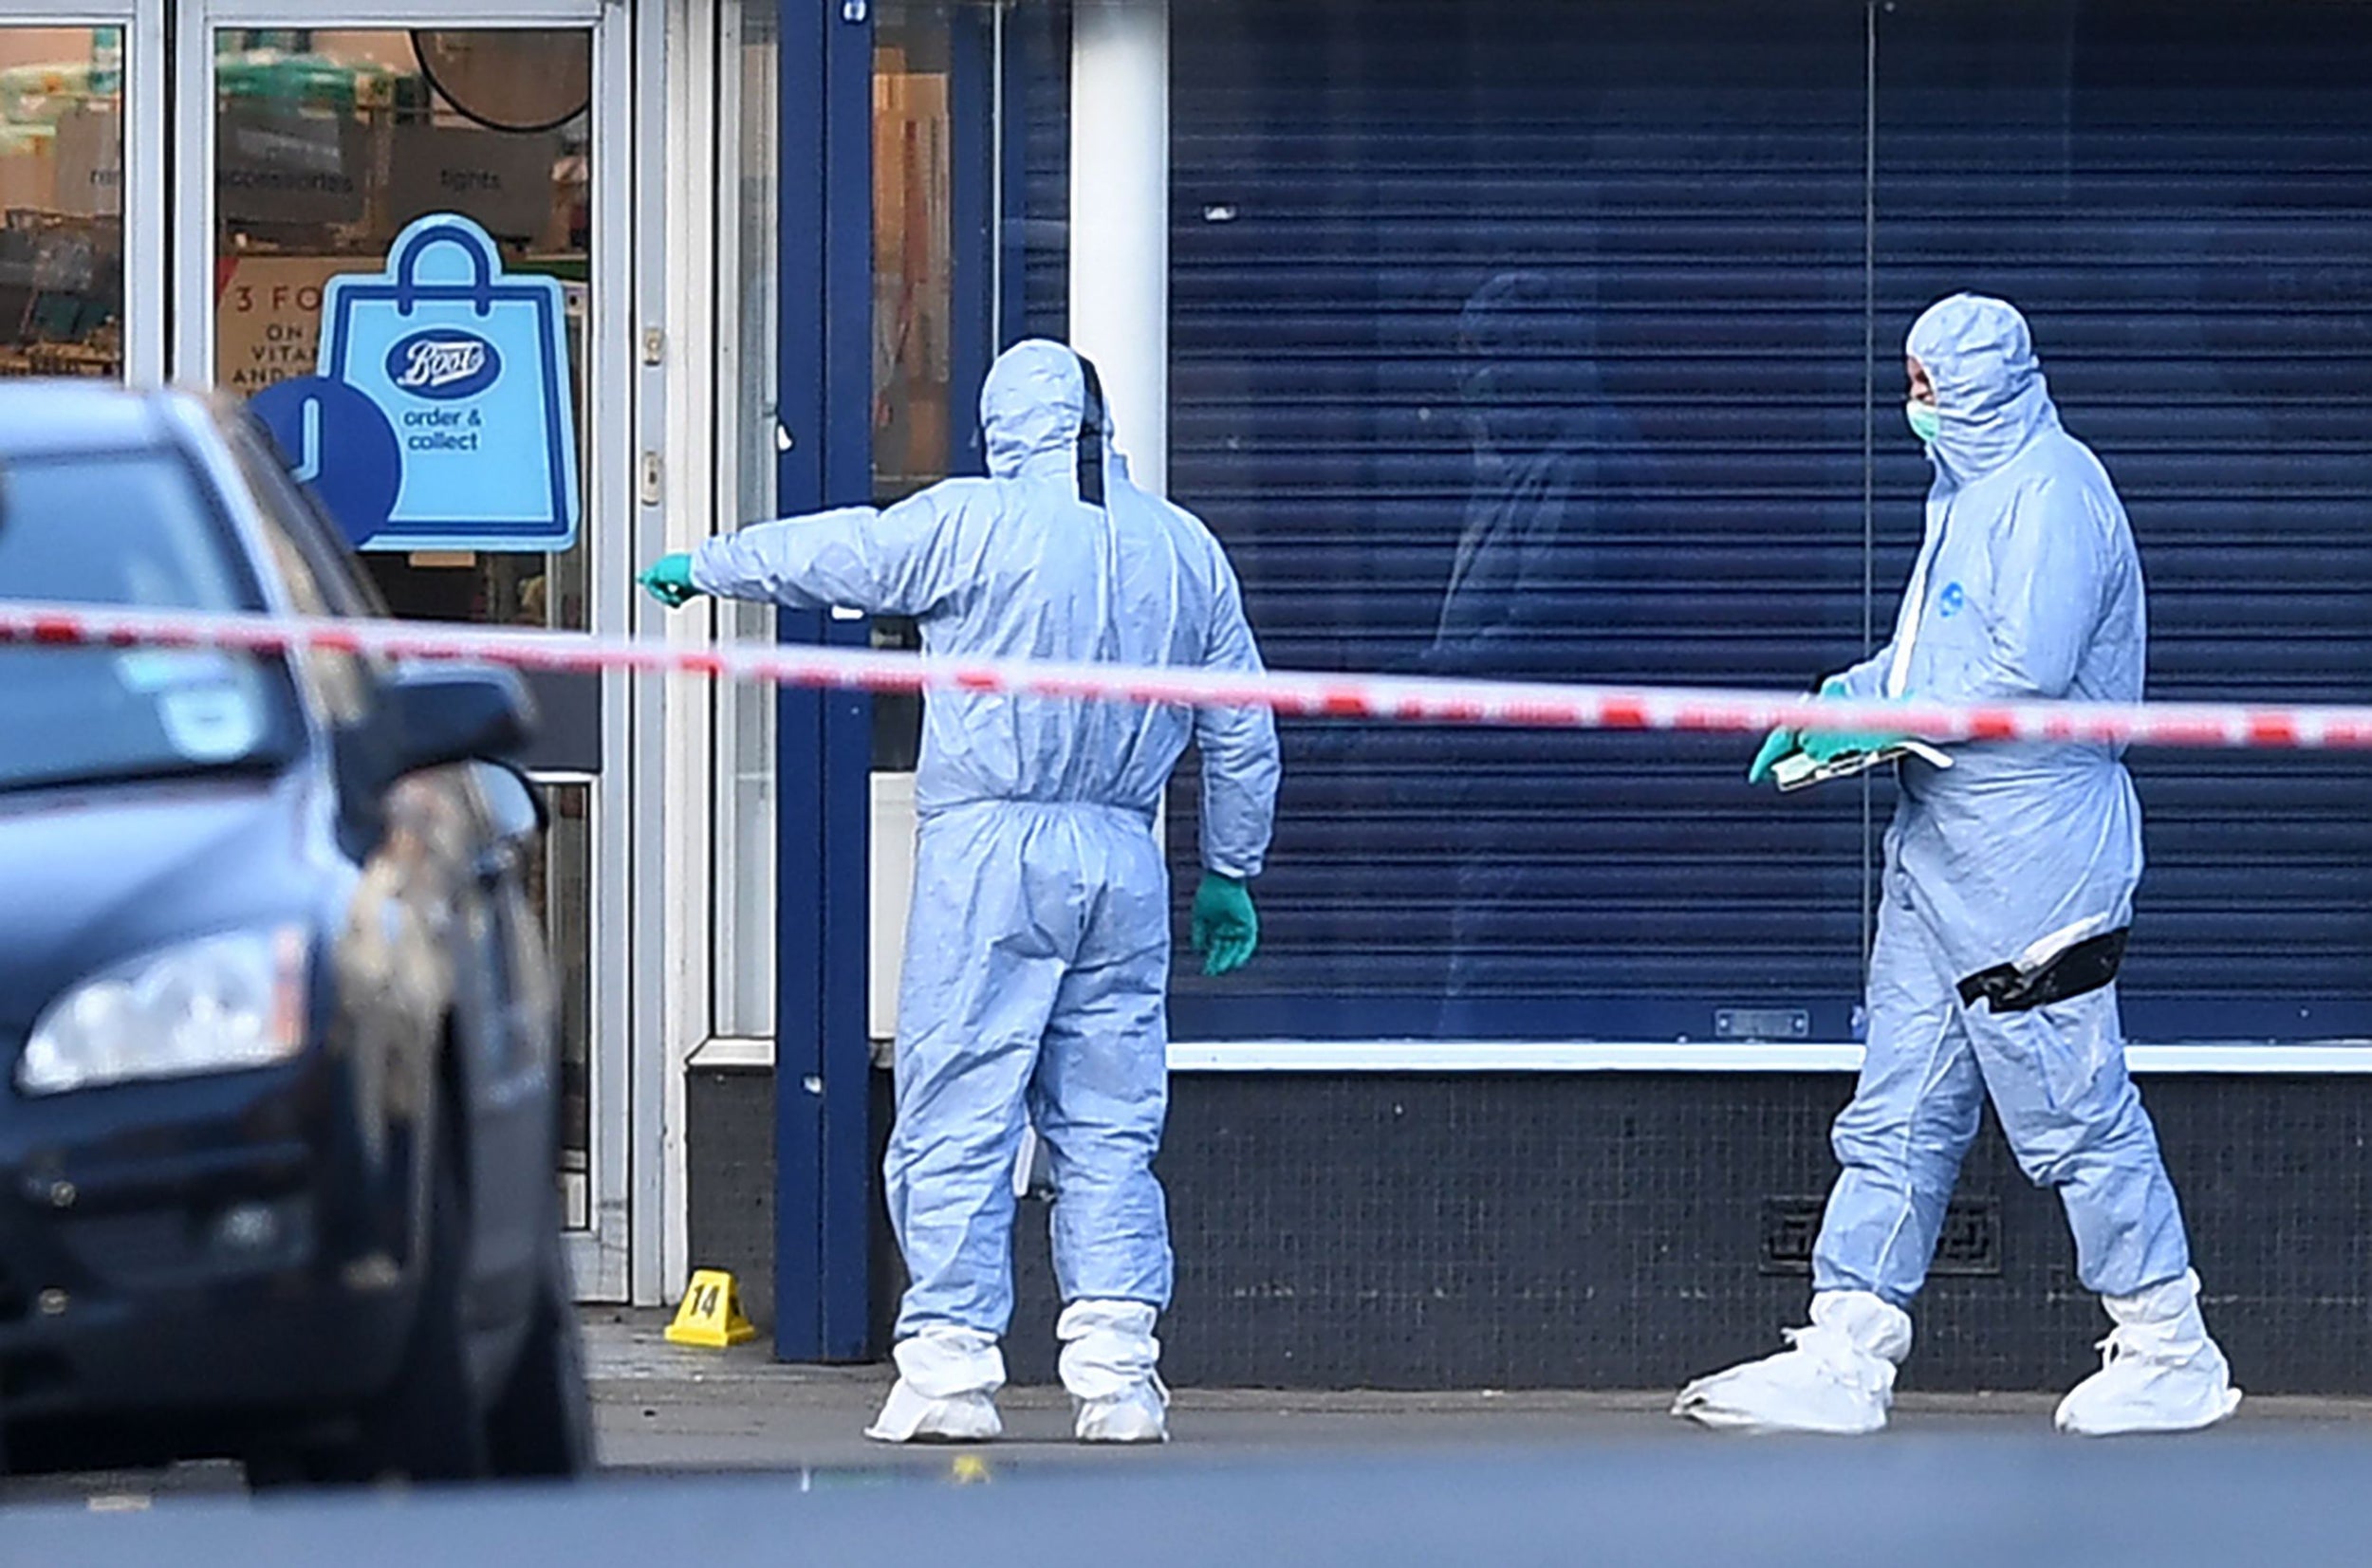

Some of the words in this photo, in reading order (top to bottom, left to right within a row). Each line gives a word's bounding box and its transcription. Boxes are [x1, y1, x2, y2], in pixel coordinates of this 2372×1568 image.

[234, 286, 253, 313] 3
[266, 323, 302, 341] ON
[397, 340, 485, 386] Boots
[403, 408, 462, 427] order
[467, 409, 482, 426] &
[408, 432, 478, 451] collect
[690, 1283, 720, 1319] 14
